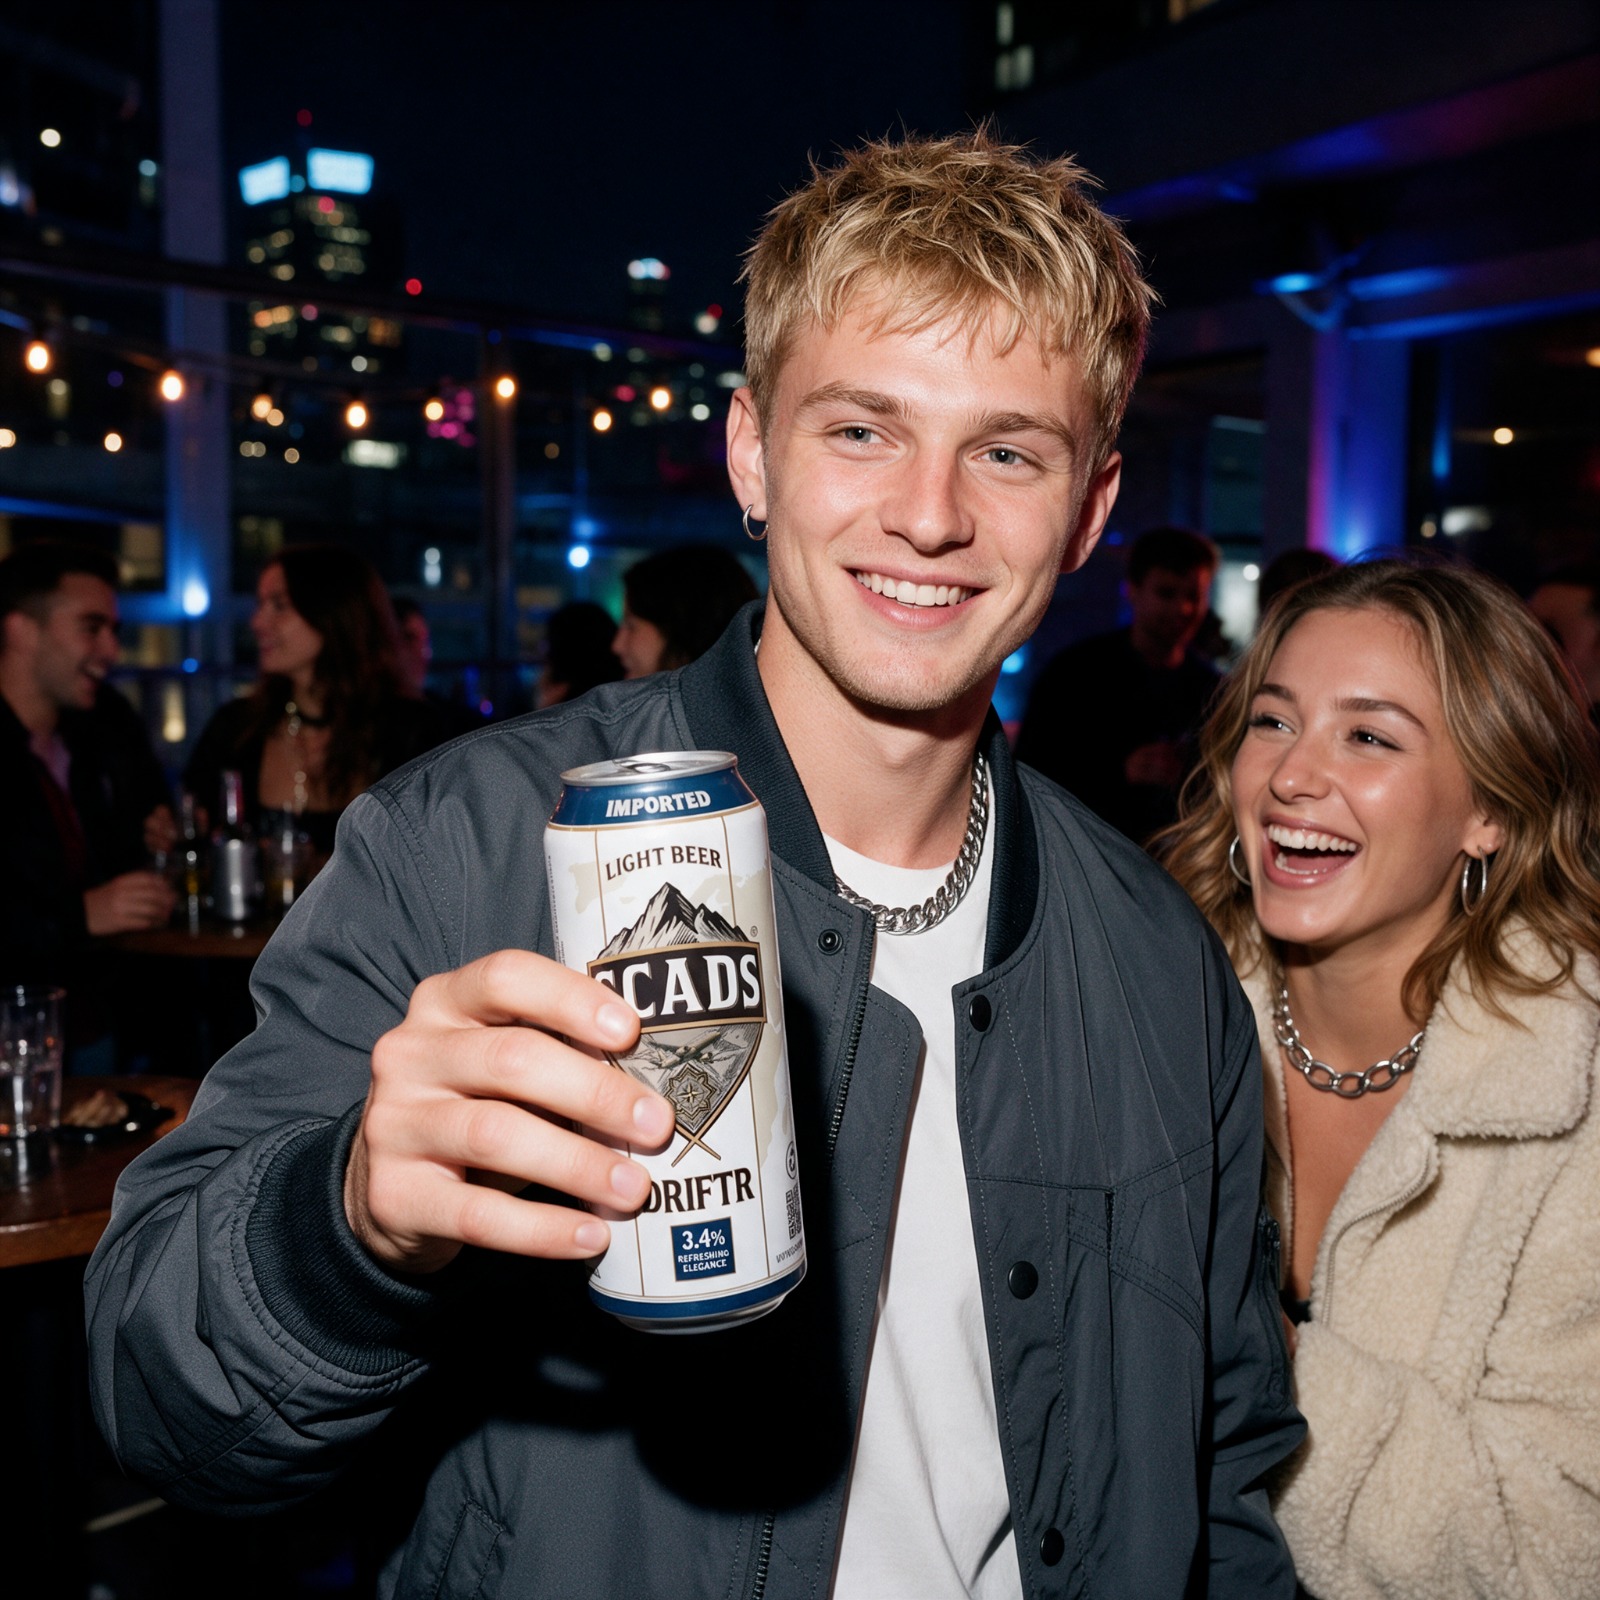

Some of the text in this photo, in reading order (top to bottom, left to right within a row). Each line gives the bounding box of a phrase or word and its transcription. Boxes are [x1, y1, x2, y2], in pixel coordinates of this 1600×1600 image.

[605, 790, 711, 817] IMPORTED
[606, 846, 722, 880] LIGHT BEER
[682, 1228, 726, 1250] 3.4%
[683, 1259, 727, 1272] ELEGANCE
